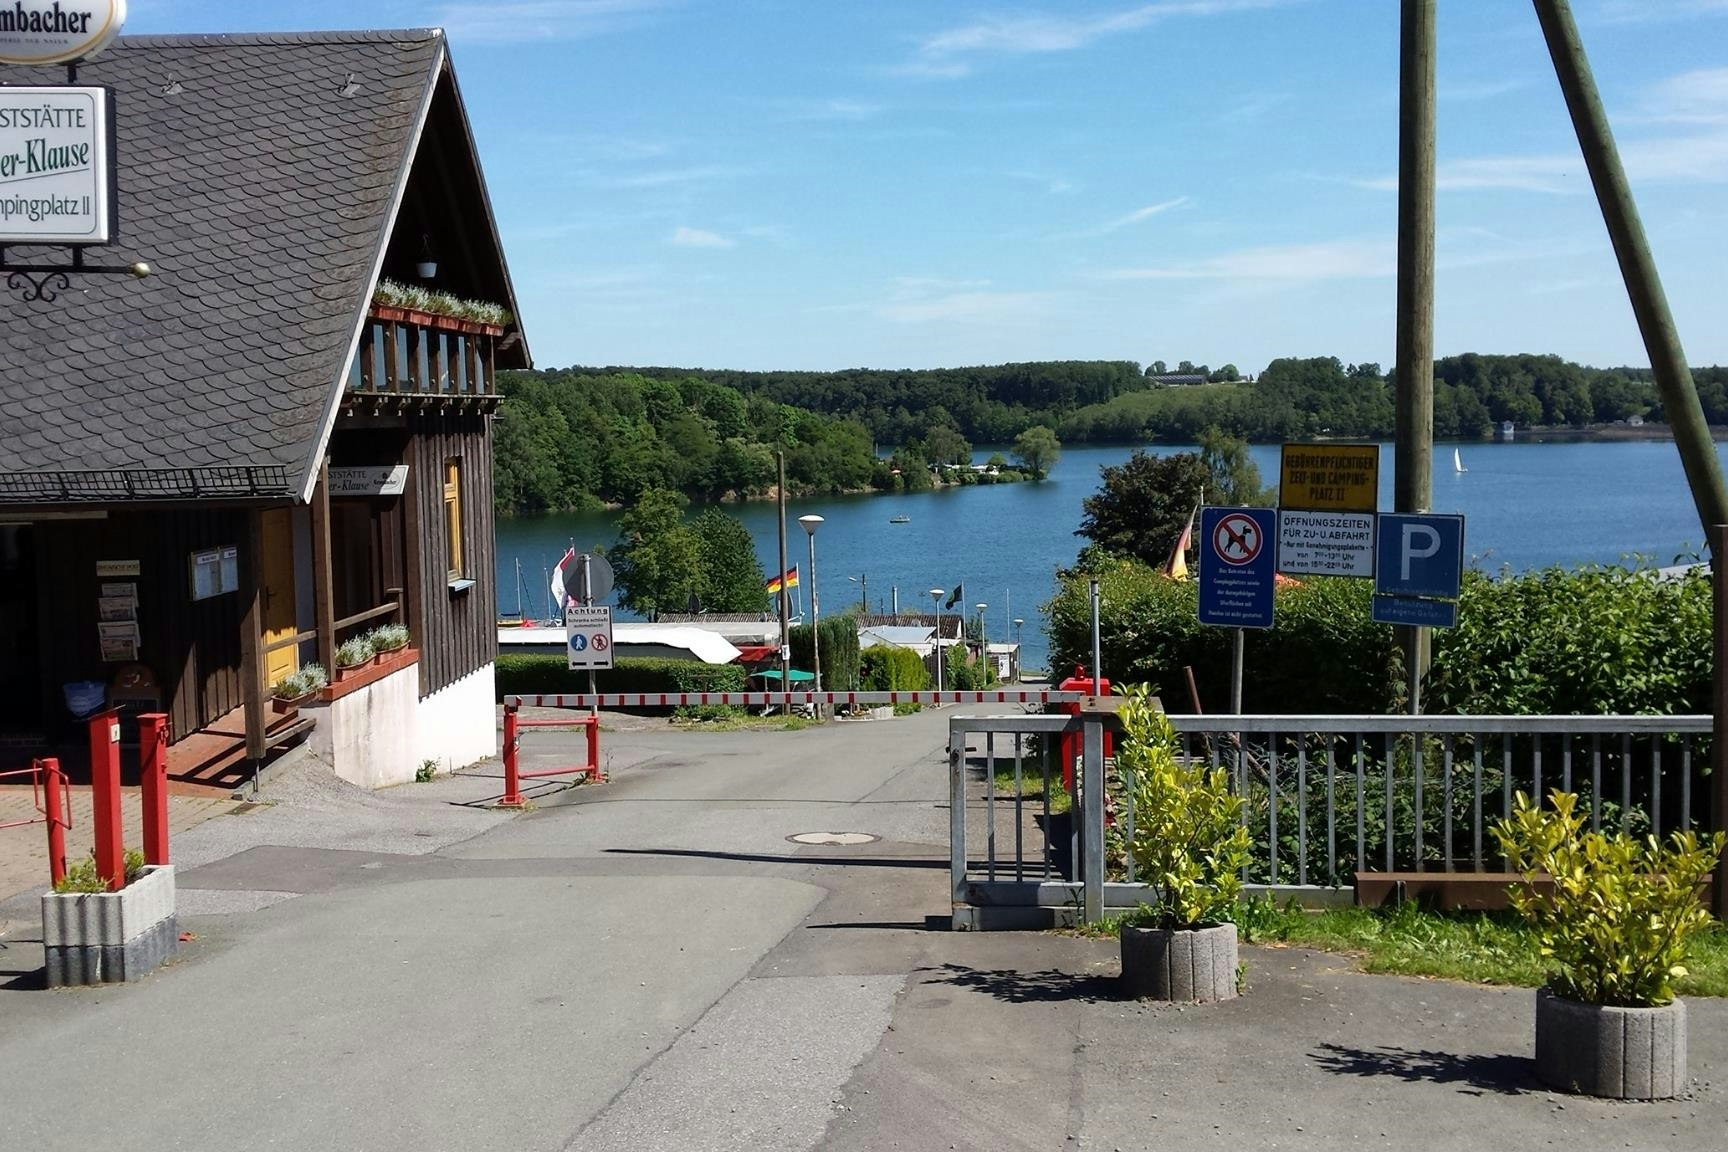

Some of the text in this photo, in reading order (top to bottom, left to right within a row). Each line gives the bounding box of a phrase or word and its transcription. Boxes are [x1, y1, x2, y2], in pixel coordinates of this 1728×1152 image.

[0, 104, 86, 128] STSTÄTTE
[0, 138, 89, 177] er-Klause
[0, 193, 79, 222] pingplatz
[1285, 453, 1374, 470] GEBÜHRENPFLICHTIGER
[1310, 487, 1345, 502] PLATZ II
[1284, 515, 1370, 529] ÖFFNUNGSZEITEN
[1283, 528, 1301, 538] FÜR
[1342, 553, 1355, 561] Uhr
[1401, 523, 1441, 580] P
[1342, 562, 1355, 570] Uhr
